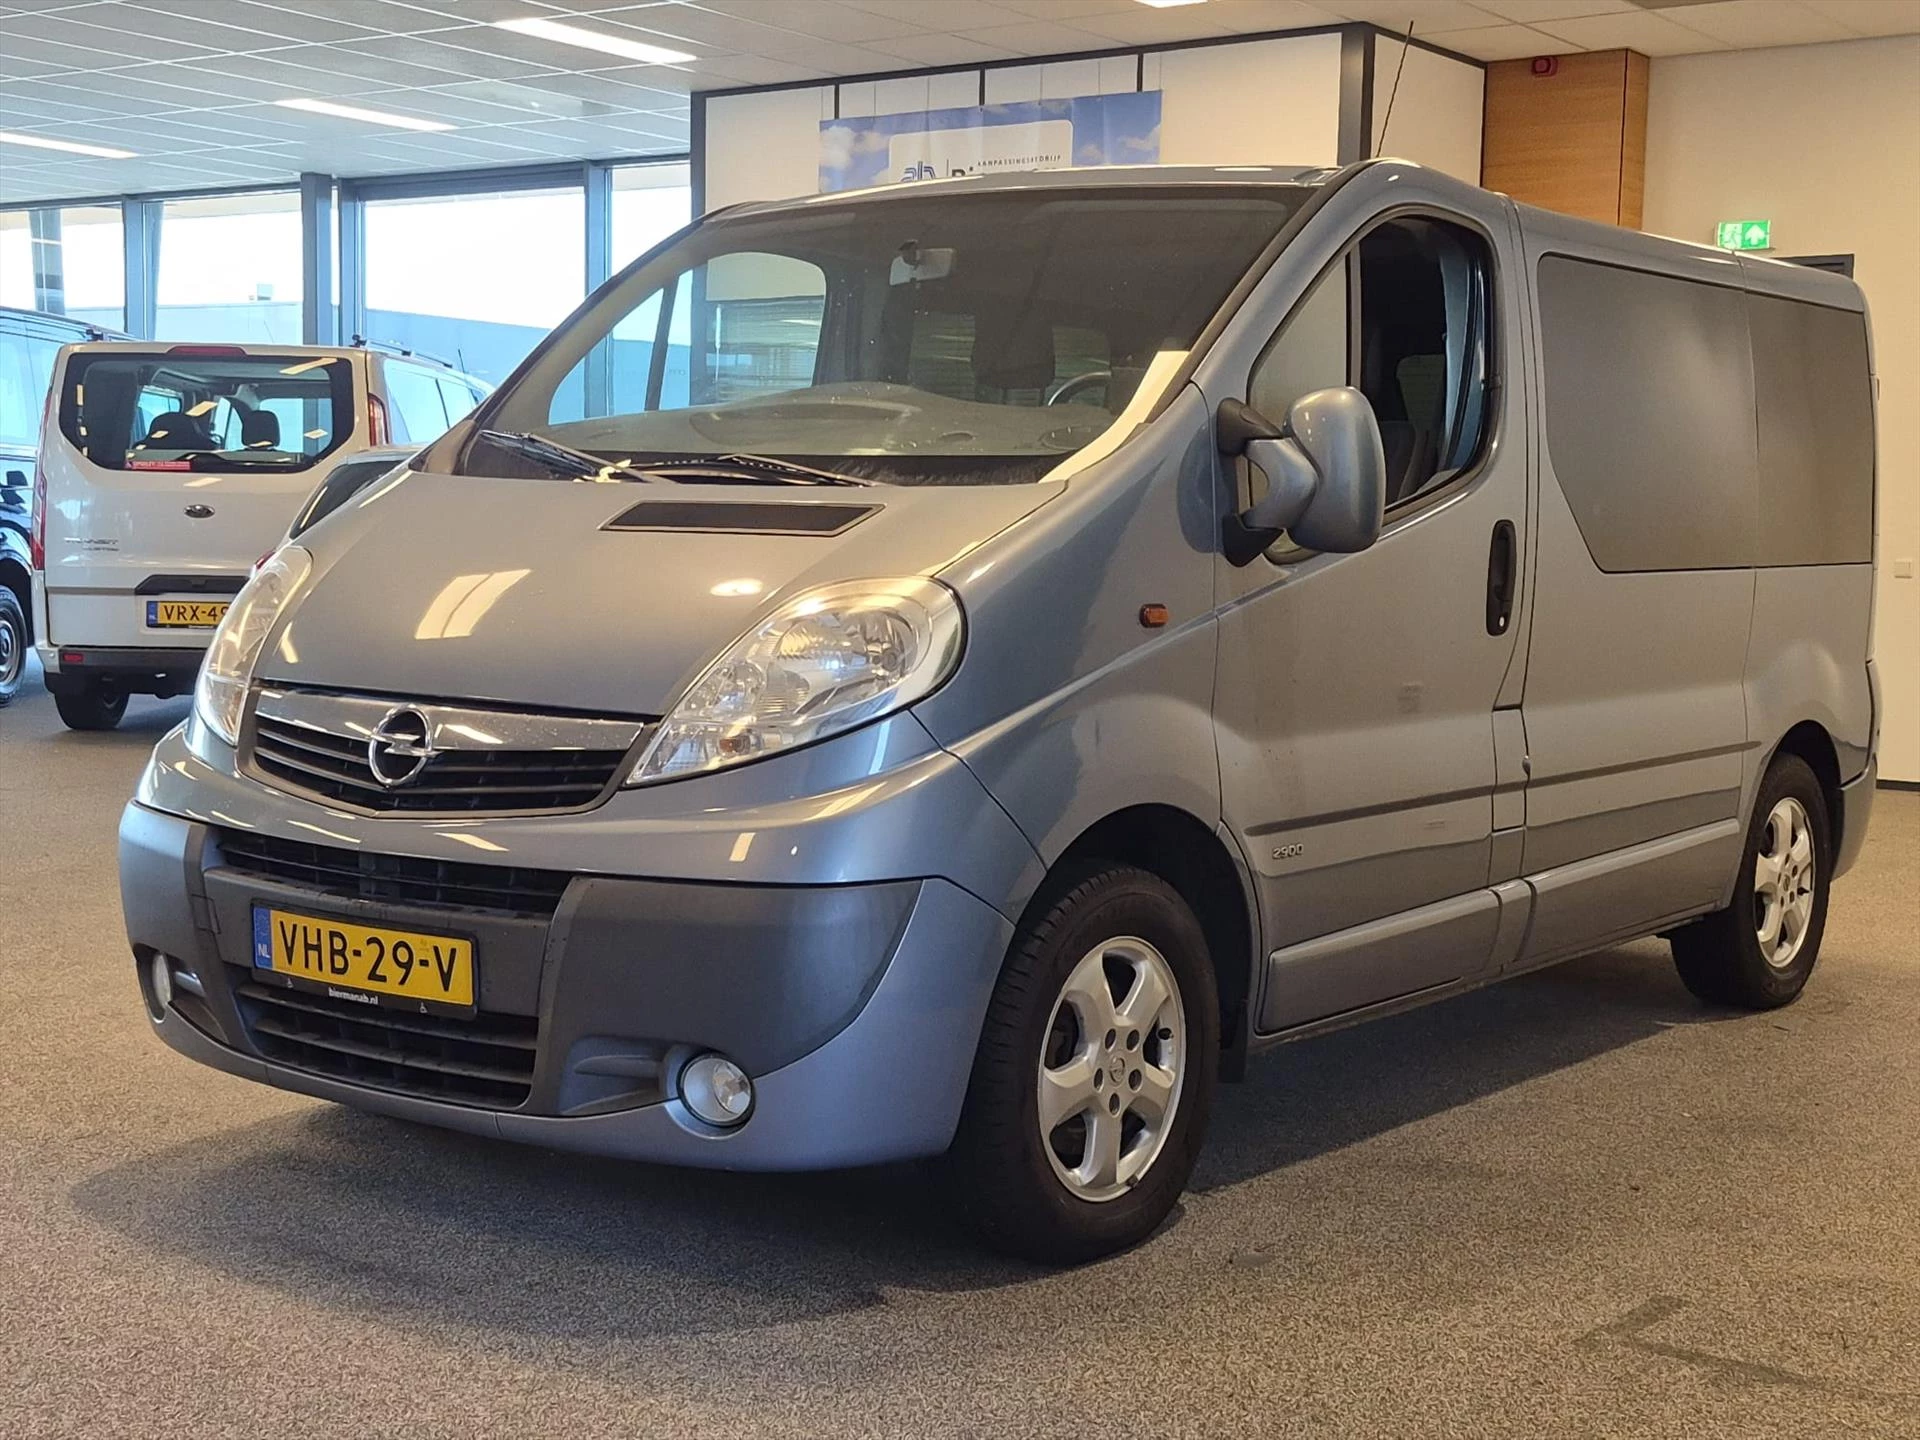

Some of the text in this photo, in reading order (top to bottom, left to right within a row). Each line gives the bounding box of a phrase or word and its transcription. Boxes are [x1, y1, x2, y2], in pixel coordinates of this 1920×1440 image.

[1272, 843, 1304, 859] 2900
[258, 943, 271, 958] NL
[279, 920, 457, 992] VHB-29-V
[328, 986, 379, 1005] biermanab.nl
